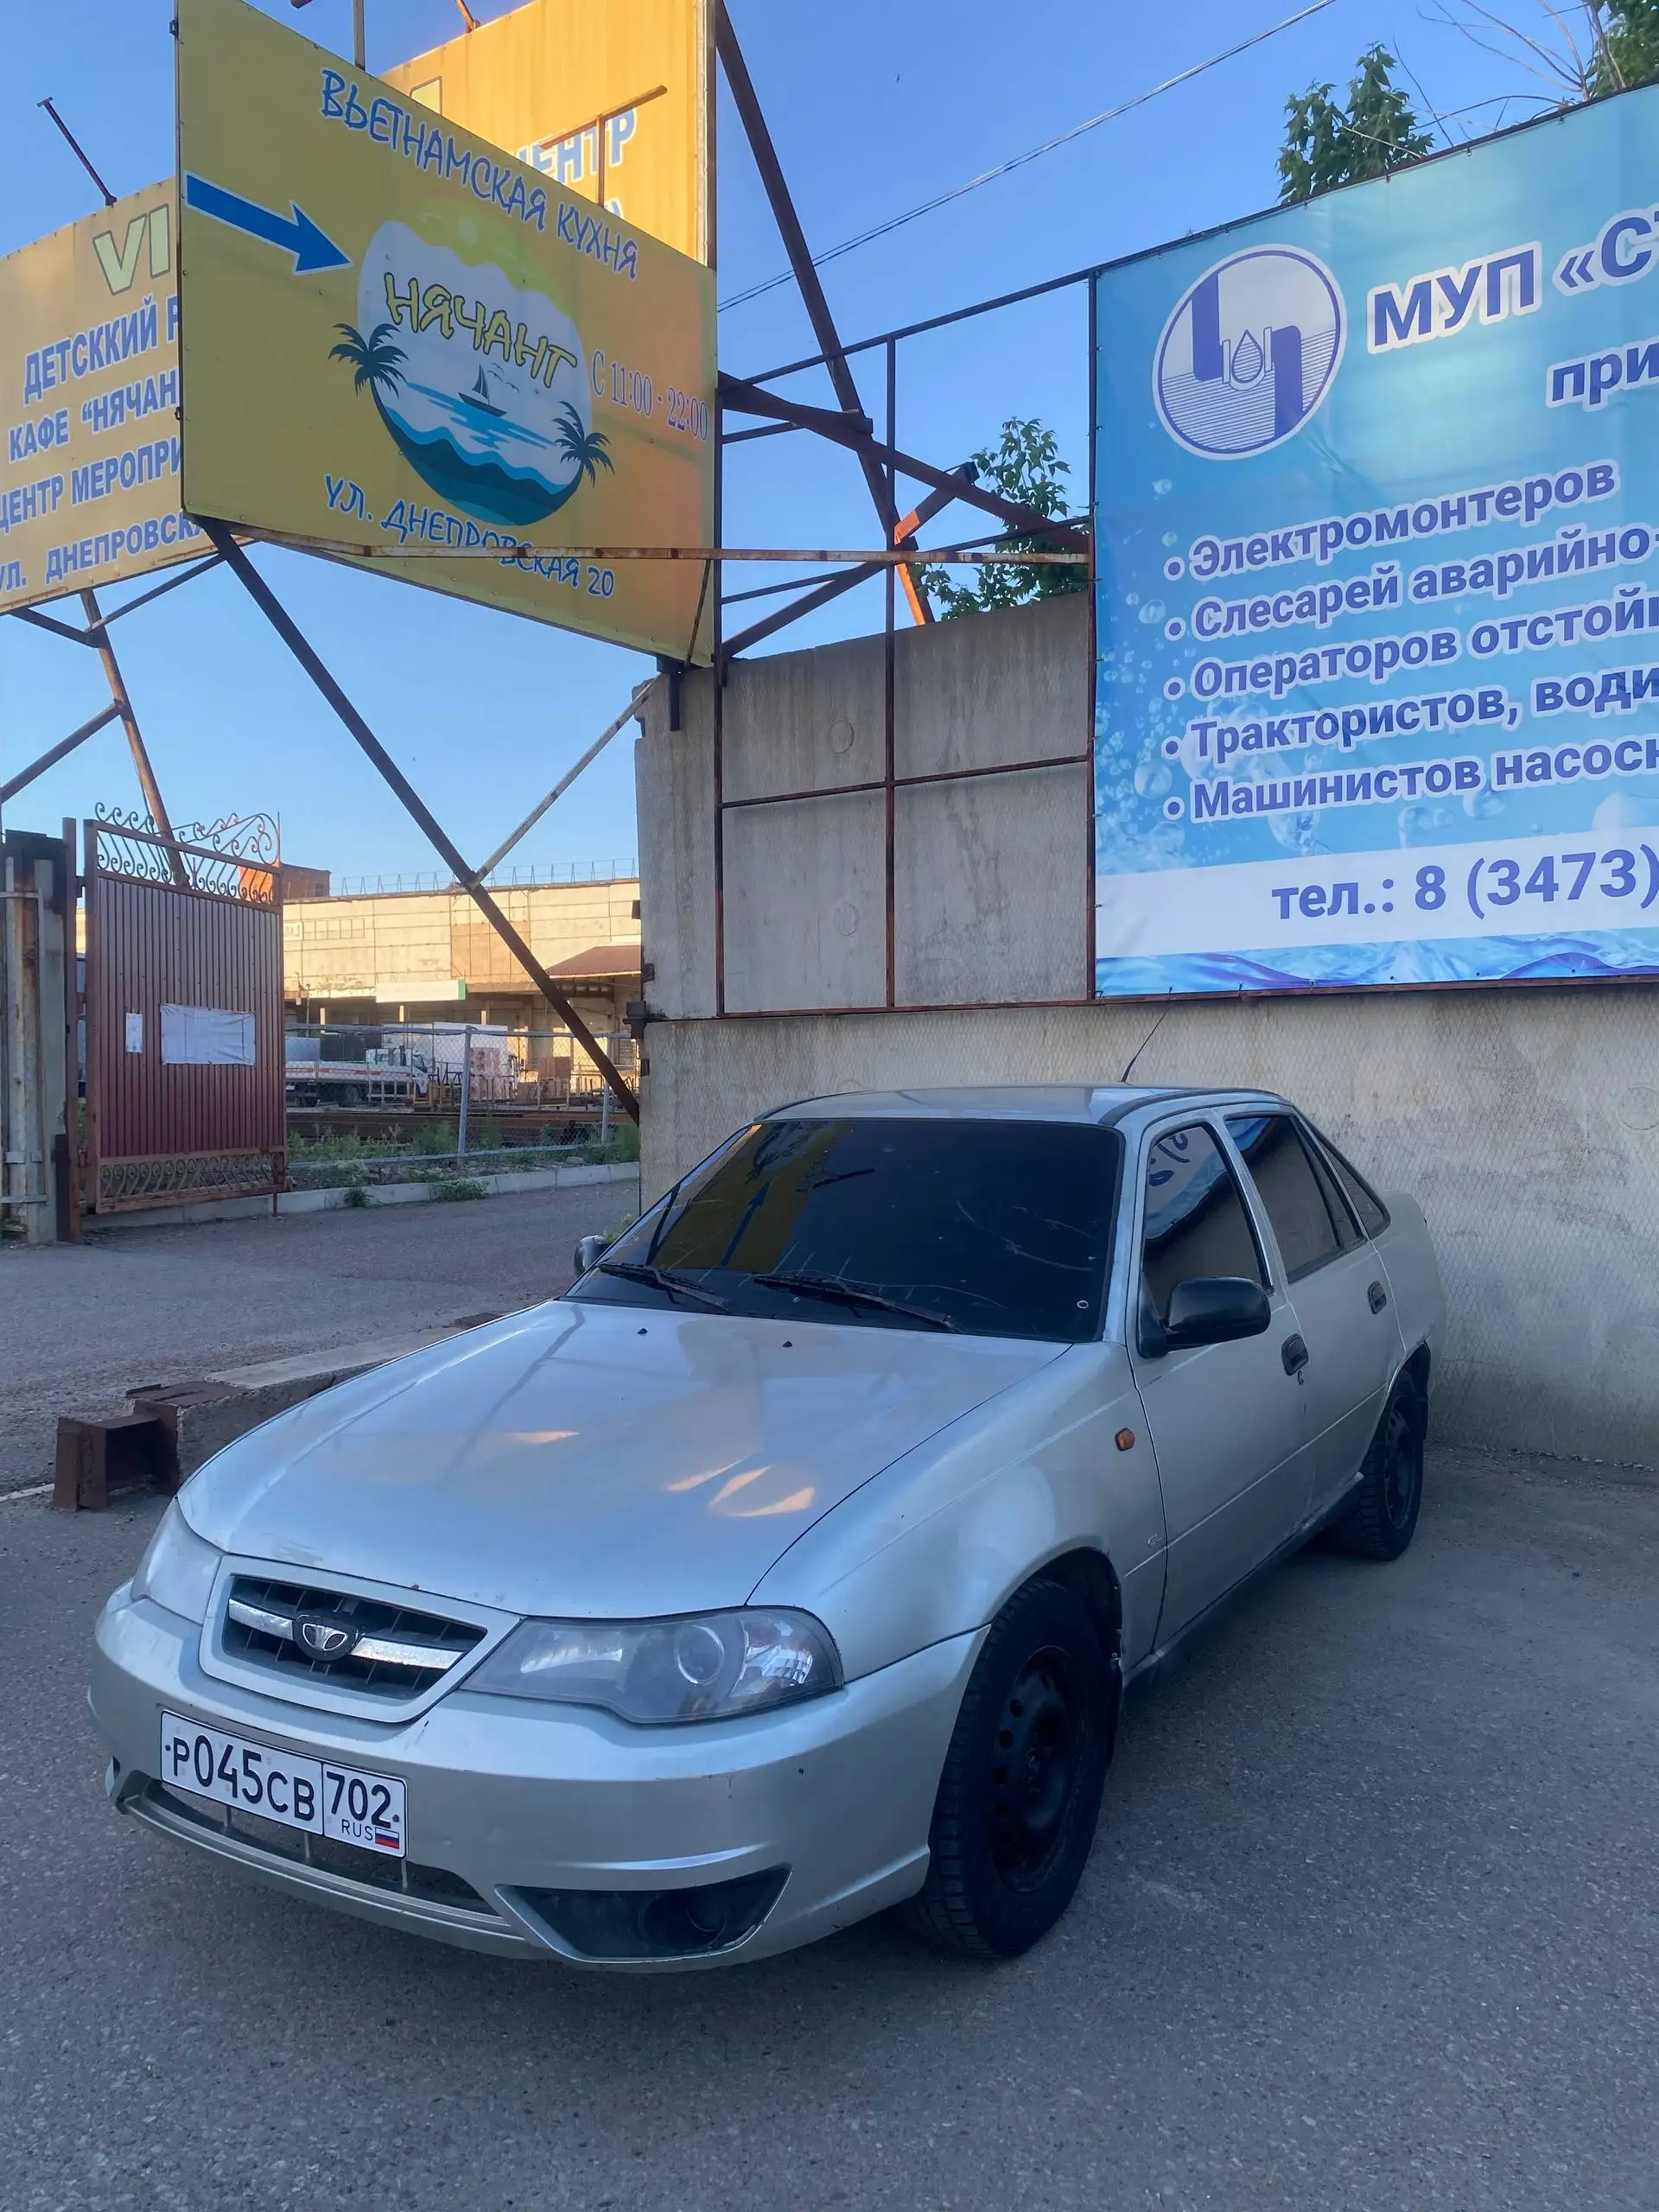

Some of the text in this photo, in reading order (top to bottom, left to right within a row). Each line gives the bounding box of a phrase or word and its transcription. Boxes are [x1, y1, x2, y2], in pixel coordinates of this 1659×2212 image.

[321, 68, 639, 280] ВЬЕТНАМСКАЯ КУХНЯ
[517, 107, 639, 185] ЕНТР
[1373, 209, 1659, 347] МУП «С
[23, 294, 158, 405] ДЕТСККИЙ
[383, 271, 577, 389] НЯЧАНГ
[10, 409, 69, 463] КАФЕ
[592, 349, 605, 397] С
[610, 361, 653, 417] 11:00
[667, 385, 709, 442] 22:00
[45, 511, 202, 586] ДНЕПРОВСК
[325, 474, 373, 521] УЛ.
[587, 566, 615, 598] 20
[1192, 464, 1616, 577] Электромонтеров
[1194, 565, 1399, 638] Слесарей
[1193, 632, 1457, 697] Операторов
[1191, 666, 1659, 765] Трактористов, води
[1194, 757, 1481, 819] Машинистов
[1271, 843, 1659, 920] тел.: 8 (3473)
[173, 1734, 391, 1829] Р045СВ 702
[341, 1818, 374, 1840] RUS
